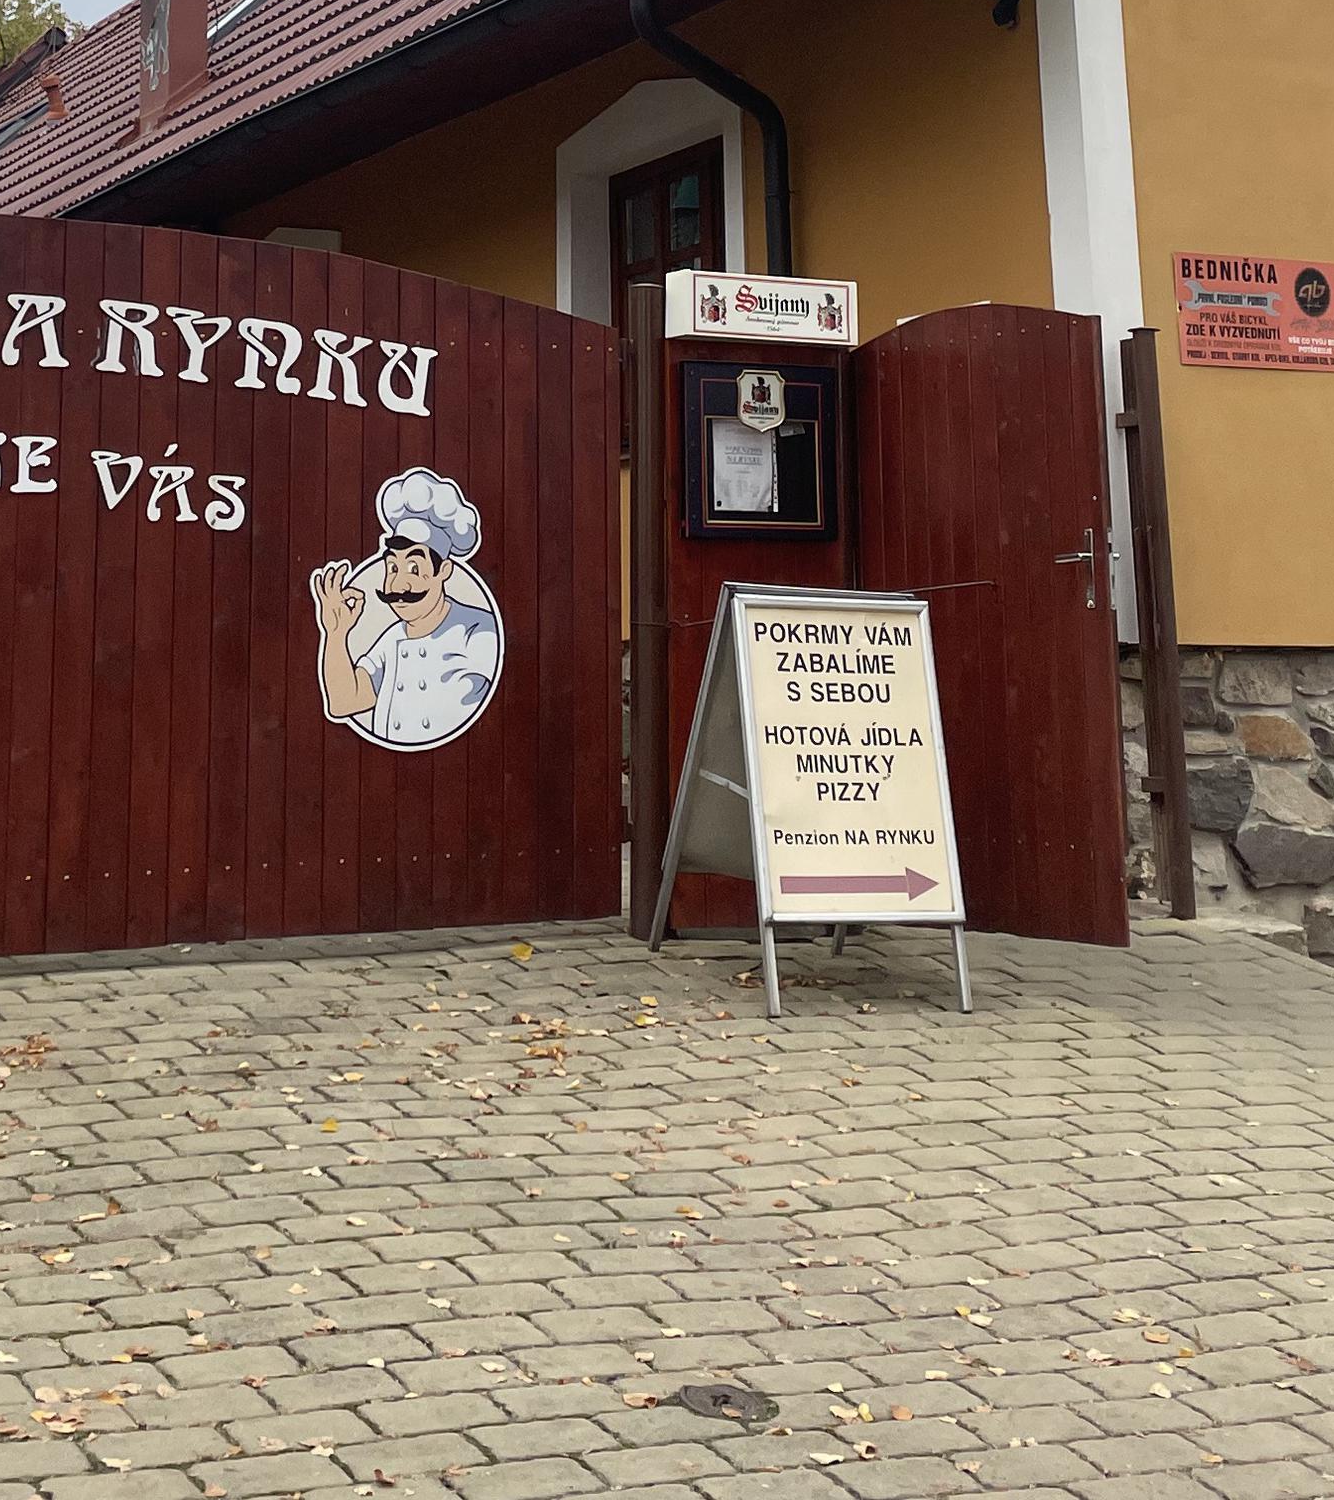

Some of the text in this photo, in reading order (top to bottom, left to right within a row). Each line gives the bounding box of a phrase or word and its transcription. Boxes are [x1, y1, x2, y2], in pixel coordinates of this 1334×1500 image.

[1181, 257, 1278, 284] BEDNIČKA
[735, 284, 810, 319] Svijany
[1200, 312, 1218, 323] PRO
[1186, 323, 1206, 336] ZDE
[1209, 324, 1216, 337] K
[1219, 325, 1281, 340] VYZVEDNUTÍ
[95, 299, 439, 417] RYNKU
[90, 442, 247, 532] VÁS
[754, 622, 912, 647] POKRMY VÁM
[776, 648, 896, 675] ZABALÍME
[787, 681, 891, 703] S SEBOU
[764, 722, 924, 747] HOTOVÁ JÍDLA
[796, 754, 895, 775] MINUTKY
[816, 782, 880, 802] PIZZY
[773, 829, 935, 846] Penzion NA RYNKU
